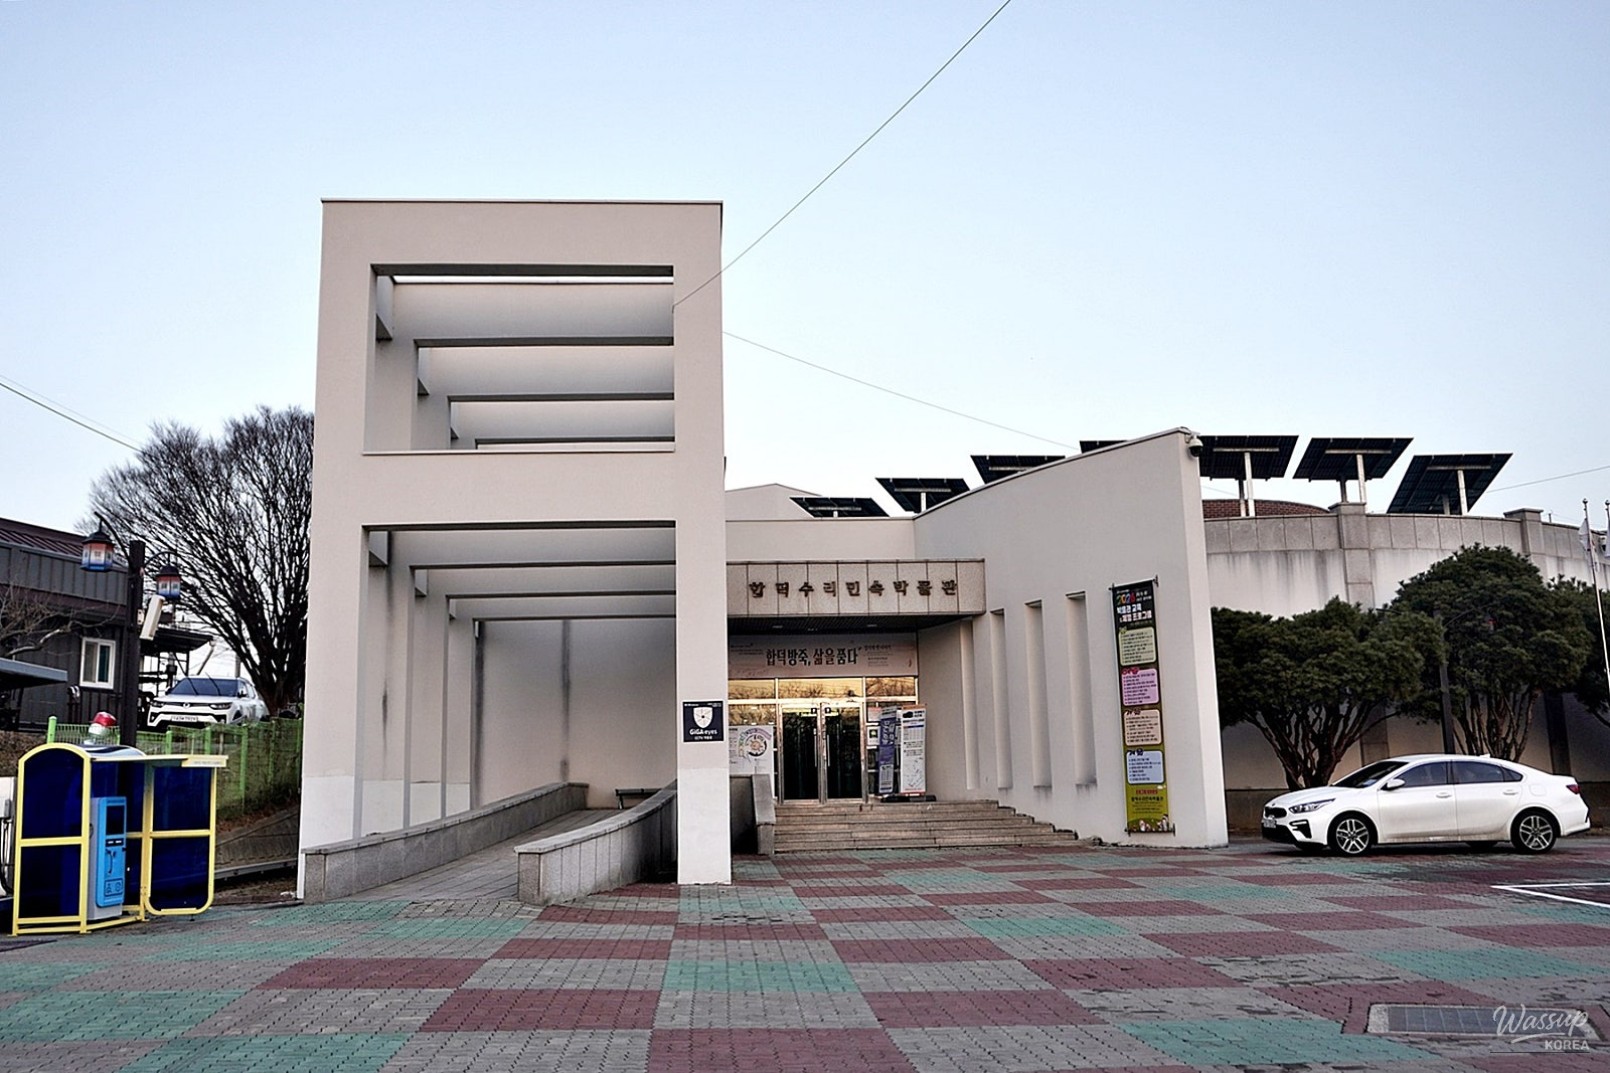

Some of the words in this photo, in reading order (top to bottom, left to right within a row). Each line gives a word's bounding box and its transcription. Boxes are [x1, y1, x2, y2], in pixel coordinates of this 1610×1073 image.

[749, 580, 957, 598] 합덕수리민속박물관
[766, 648, 811, 666] 합덕방죽,
[813, 648, 835, 665] 삶을
[837, 647, 859, 665] 품다
